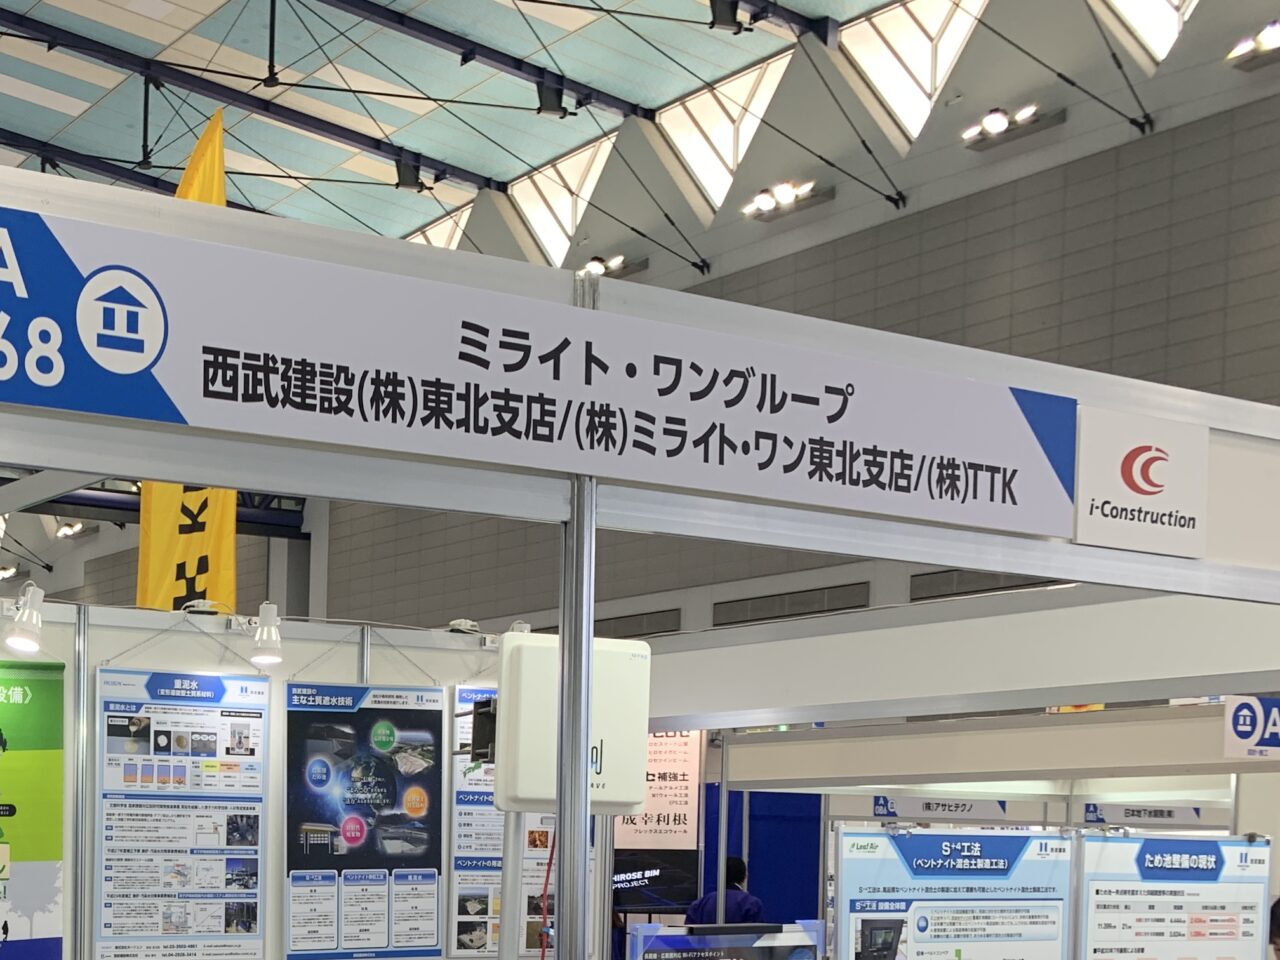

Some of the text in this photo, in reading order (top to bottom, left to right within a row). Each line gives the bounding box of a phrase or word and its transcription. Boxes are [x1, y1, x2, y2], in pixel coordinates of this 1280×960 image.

[457, 319, 856, 425] ミライト・ワングループ
[1088, 494, 1198, 531] i-Construction
[644, 869, 660, 878] BIM
